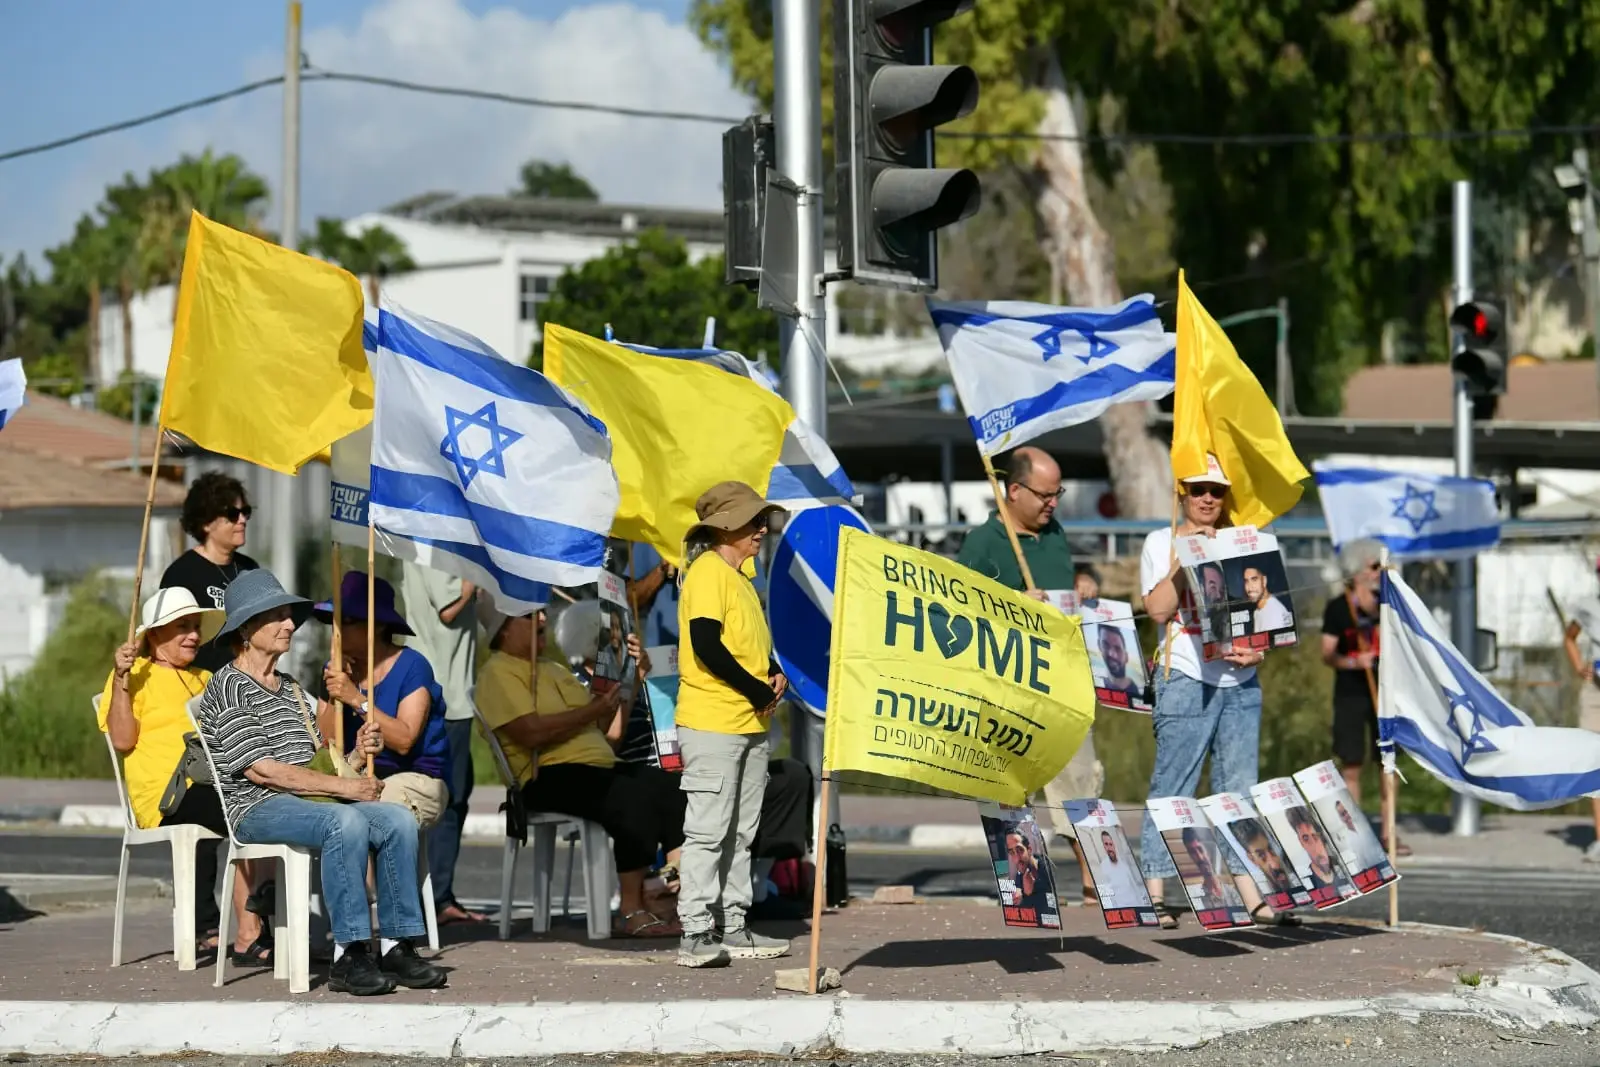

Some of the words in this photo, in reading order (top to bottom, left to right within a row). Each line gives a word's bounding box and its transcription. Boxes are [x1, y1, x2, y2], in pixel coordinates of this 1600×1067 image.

[883, 554, 969, 605] BRING
[971, 586, 1049, 635] THEM
[875, 688, 980, 739] העשרה
[874, 725, 946, 757] החטופים
[981, 718, 1033, 757] נתיב
